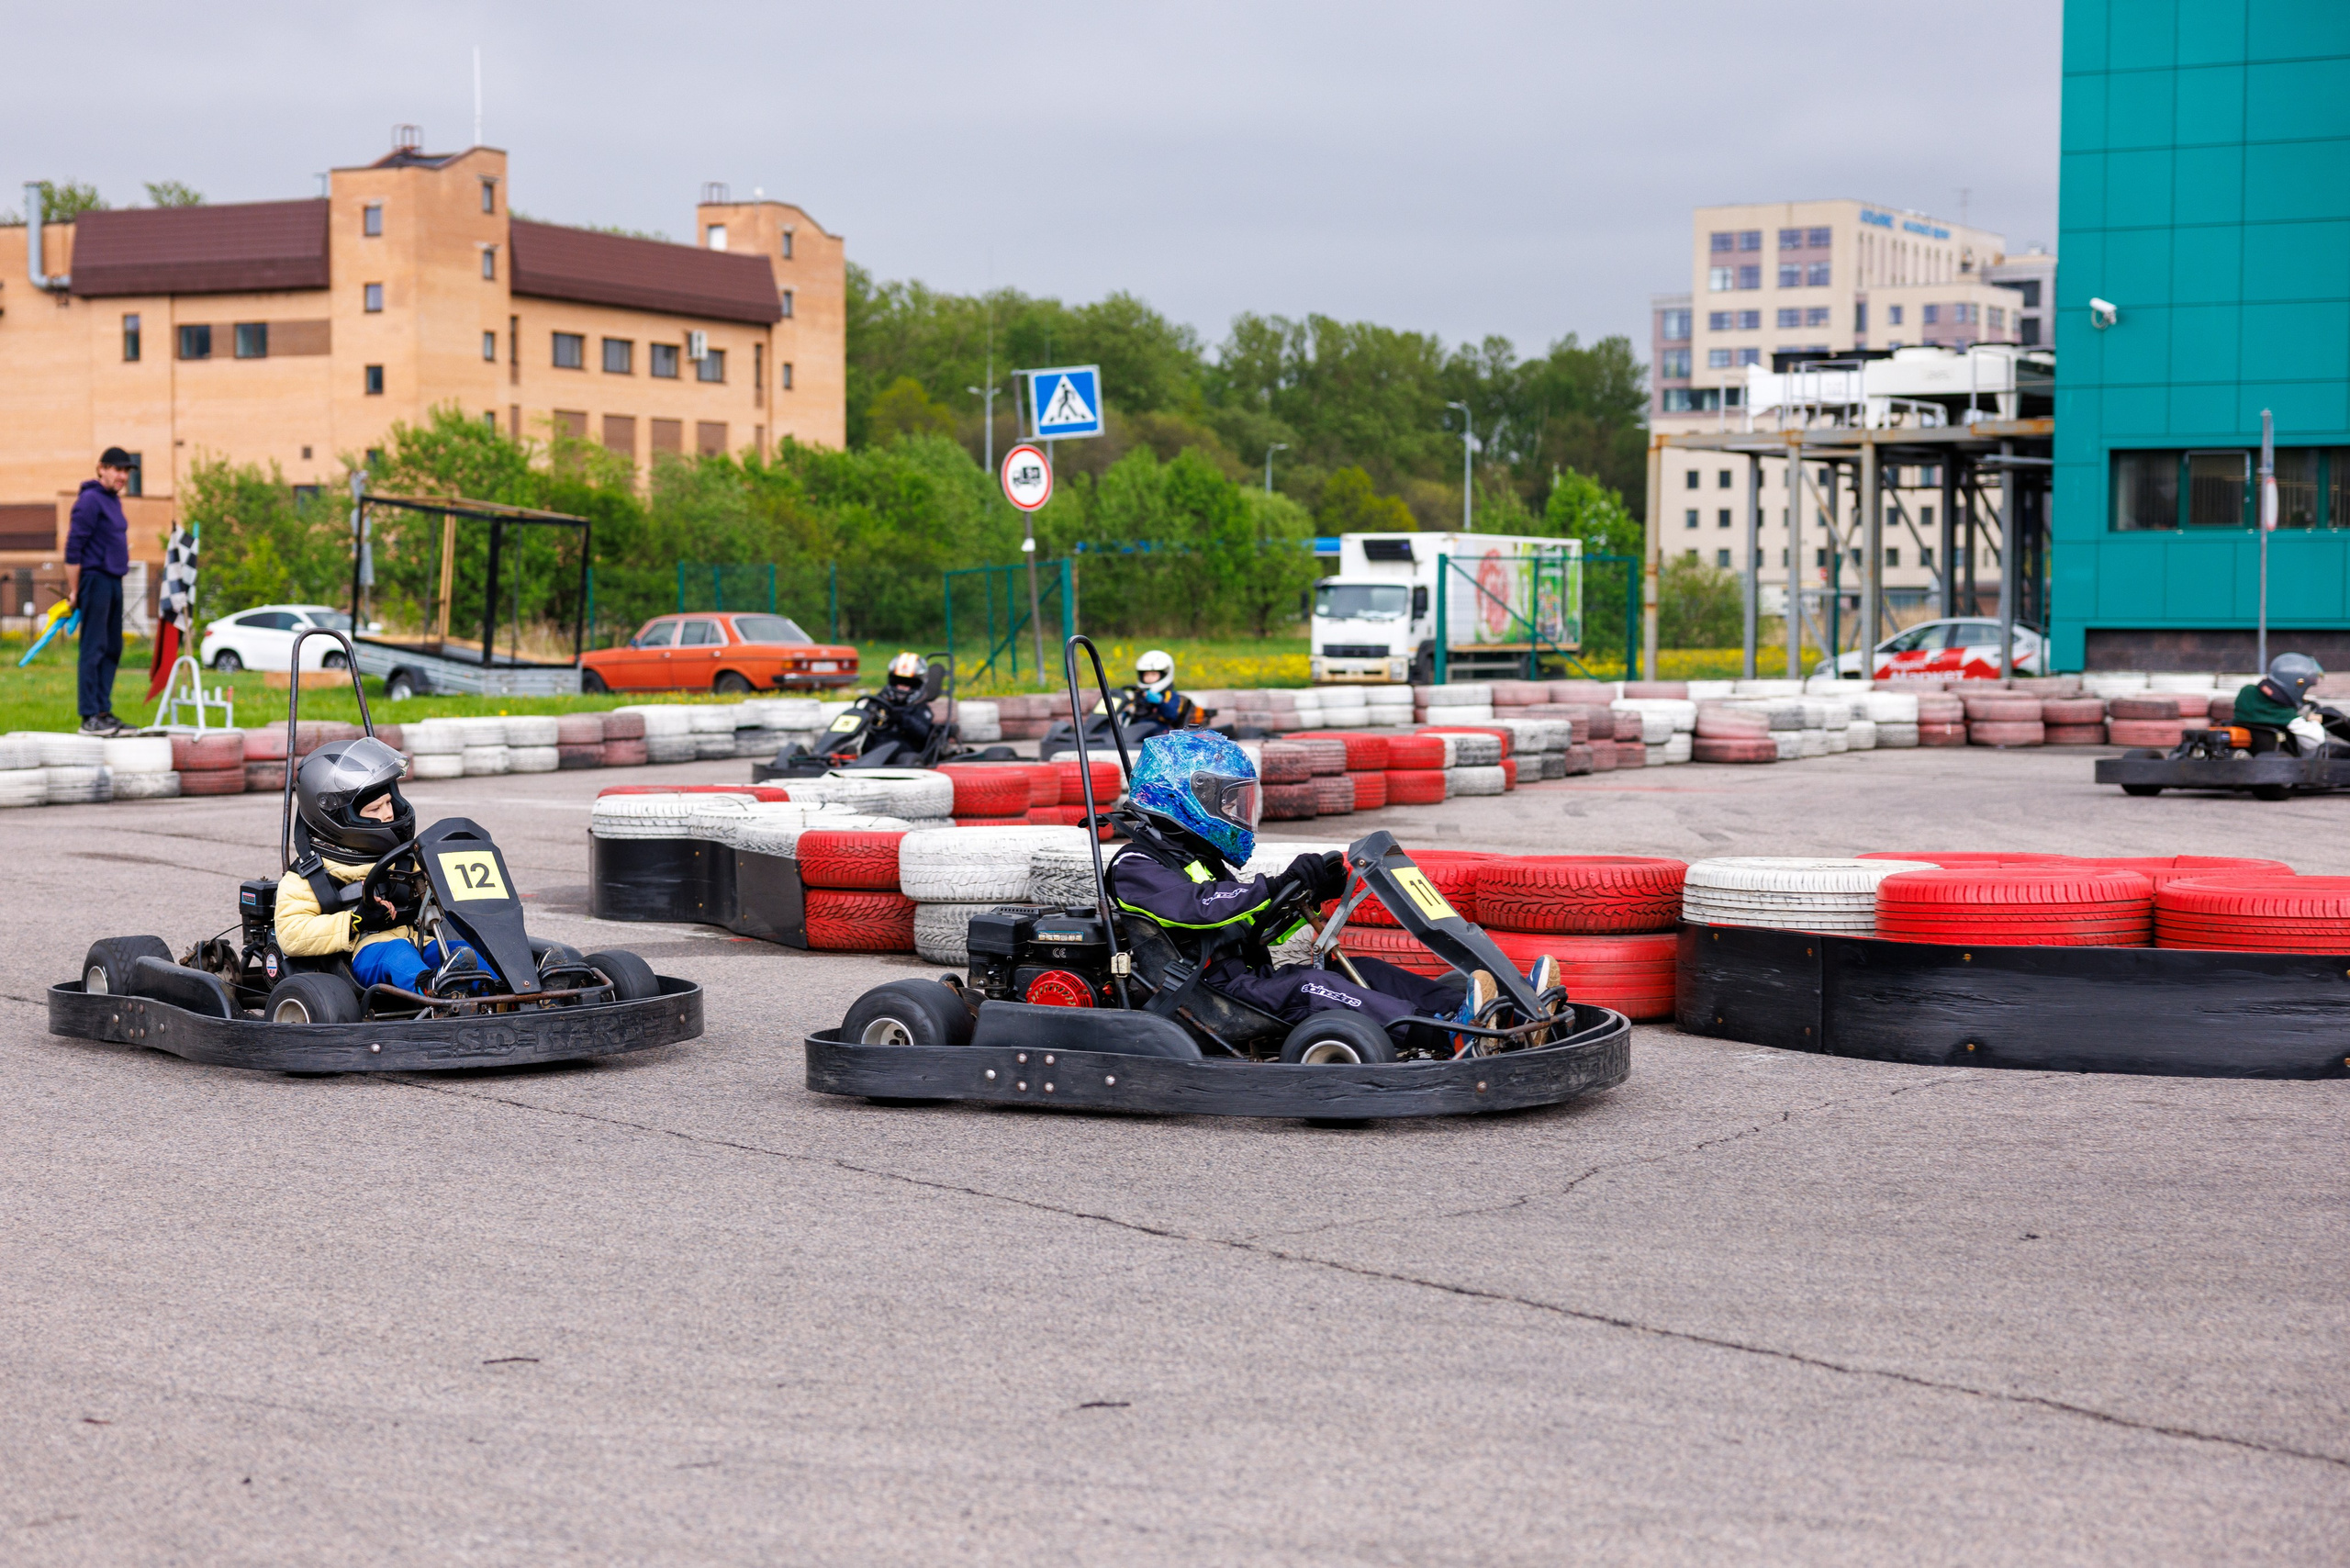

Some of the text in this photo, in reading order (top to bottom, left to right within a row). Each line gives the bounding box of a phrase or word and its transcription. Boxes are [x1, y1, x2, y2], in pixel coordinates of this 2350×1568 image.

[454, 863, 496, 889] 12
[1409, 879, 1441, 907] 11
[1052, 947, 1067, 958] CE
[1301, 982, 1362, 1007] alpinestars
